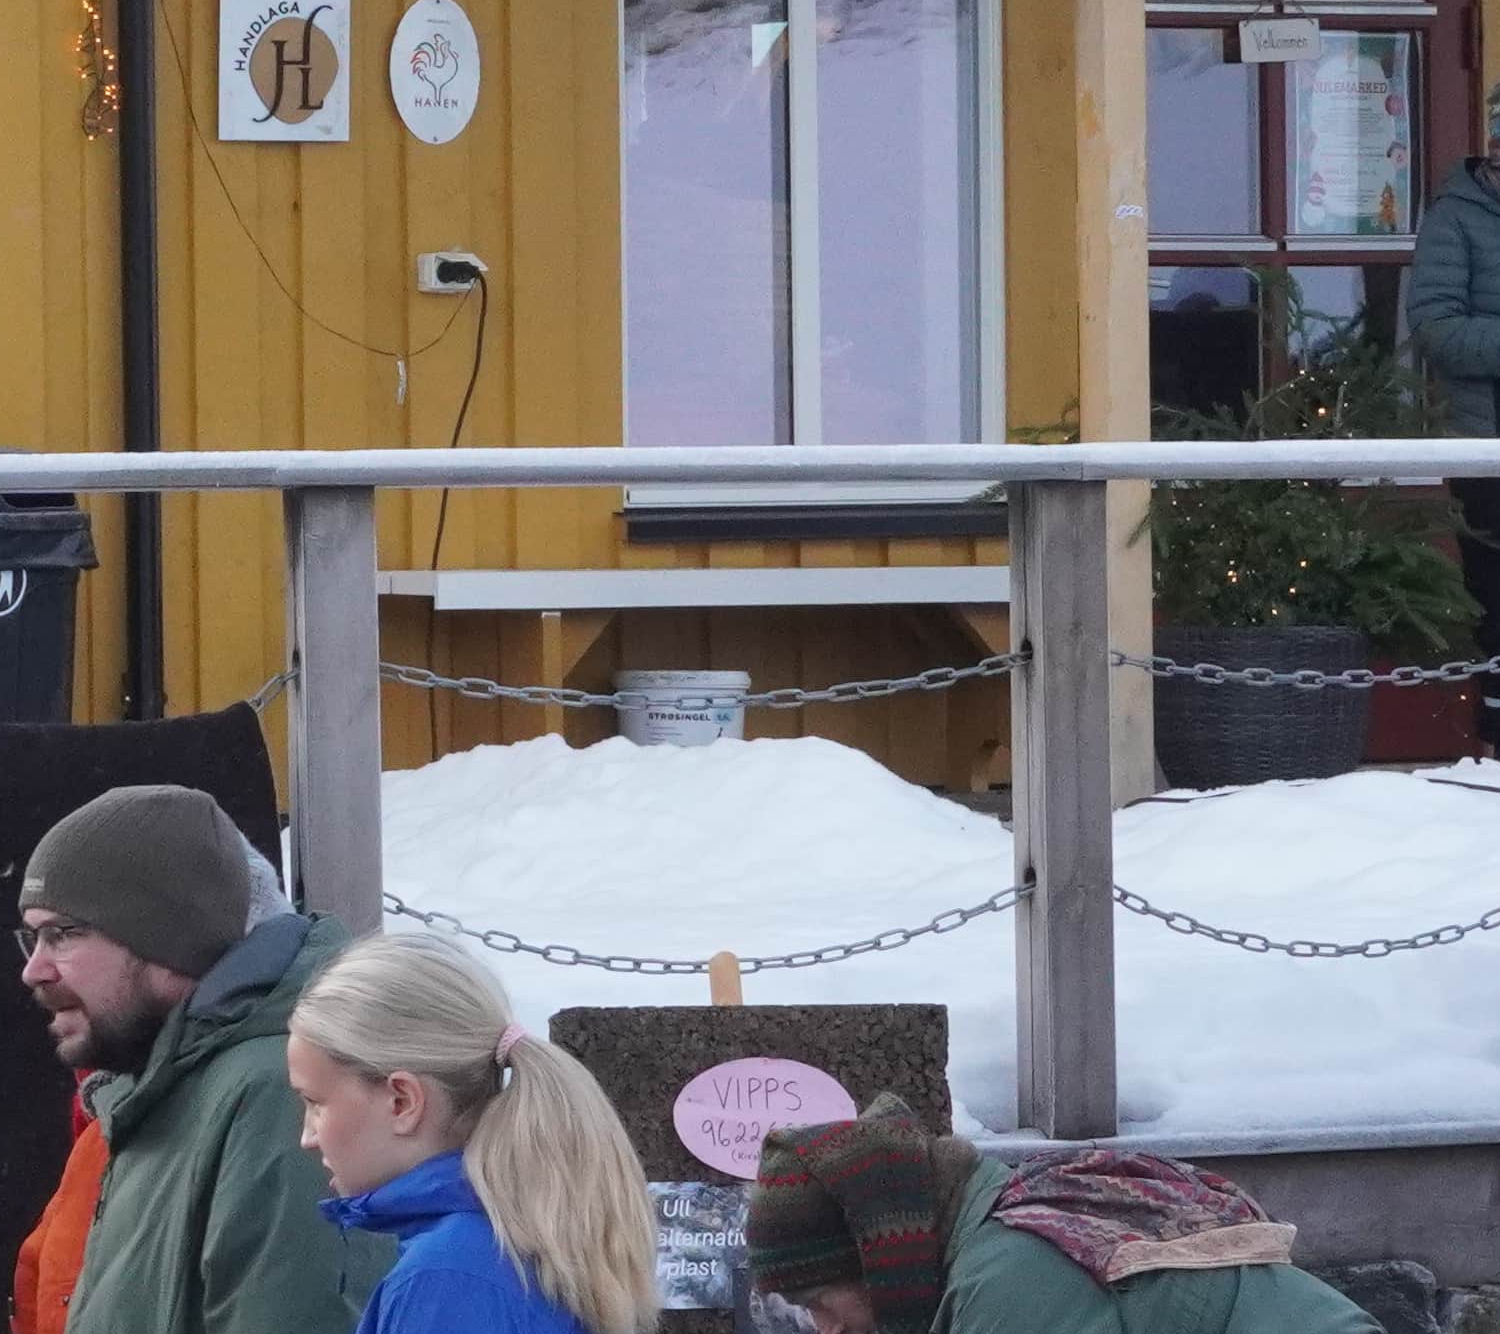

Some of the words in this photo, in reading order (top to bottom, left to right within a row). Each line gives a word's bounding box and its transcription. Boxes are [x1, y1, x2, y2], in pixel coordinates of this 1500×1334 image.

[234, 1, 300, 71] HANDLAGA
[712, 1076, 803, 1111] VIPPS
[663, 1199, 690, 1218] Ull
[666, 1258, 718, 1281] plast
